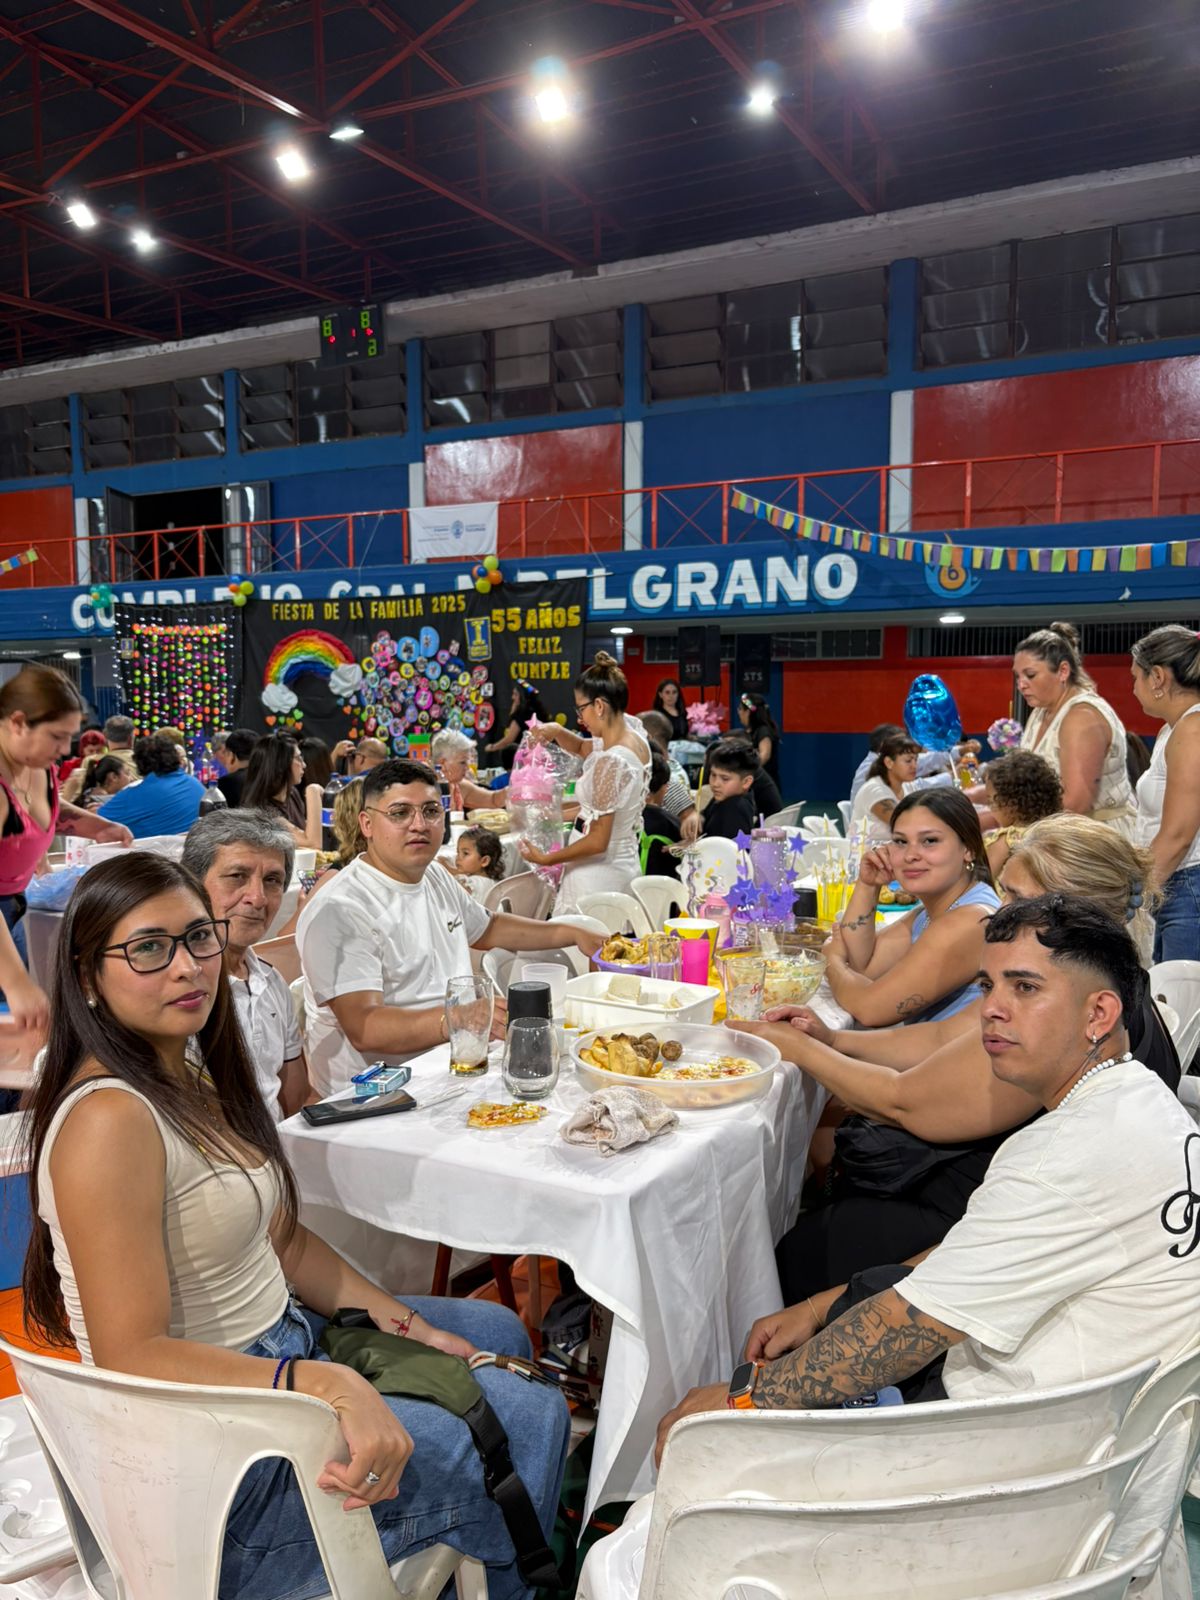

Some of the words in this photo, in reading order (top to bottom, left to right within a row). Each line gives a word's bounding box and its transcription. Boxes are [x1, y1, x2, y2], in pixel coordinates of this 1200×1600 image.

[322, 319, 332, 337] 8
[517, 553, 858, 609] LGRANO
[272, 603, 315, 621] FIESTA
[324, 603, 340, 620] DE
[350, 602, 364, 620] LA
[370, 598, 424, 620] FAMILIA
[432, 594, 466, 613] 2025
[491, 607, 522, 633] 55
[525, 601, 581, 630] AÑOS
[518, 636, 562, 655] FELIZ
[510, 661, 571, 680] CUMPLE
